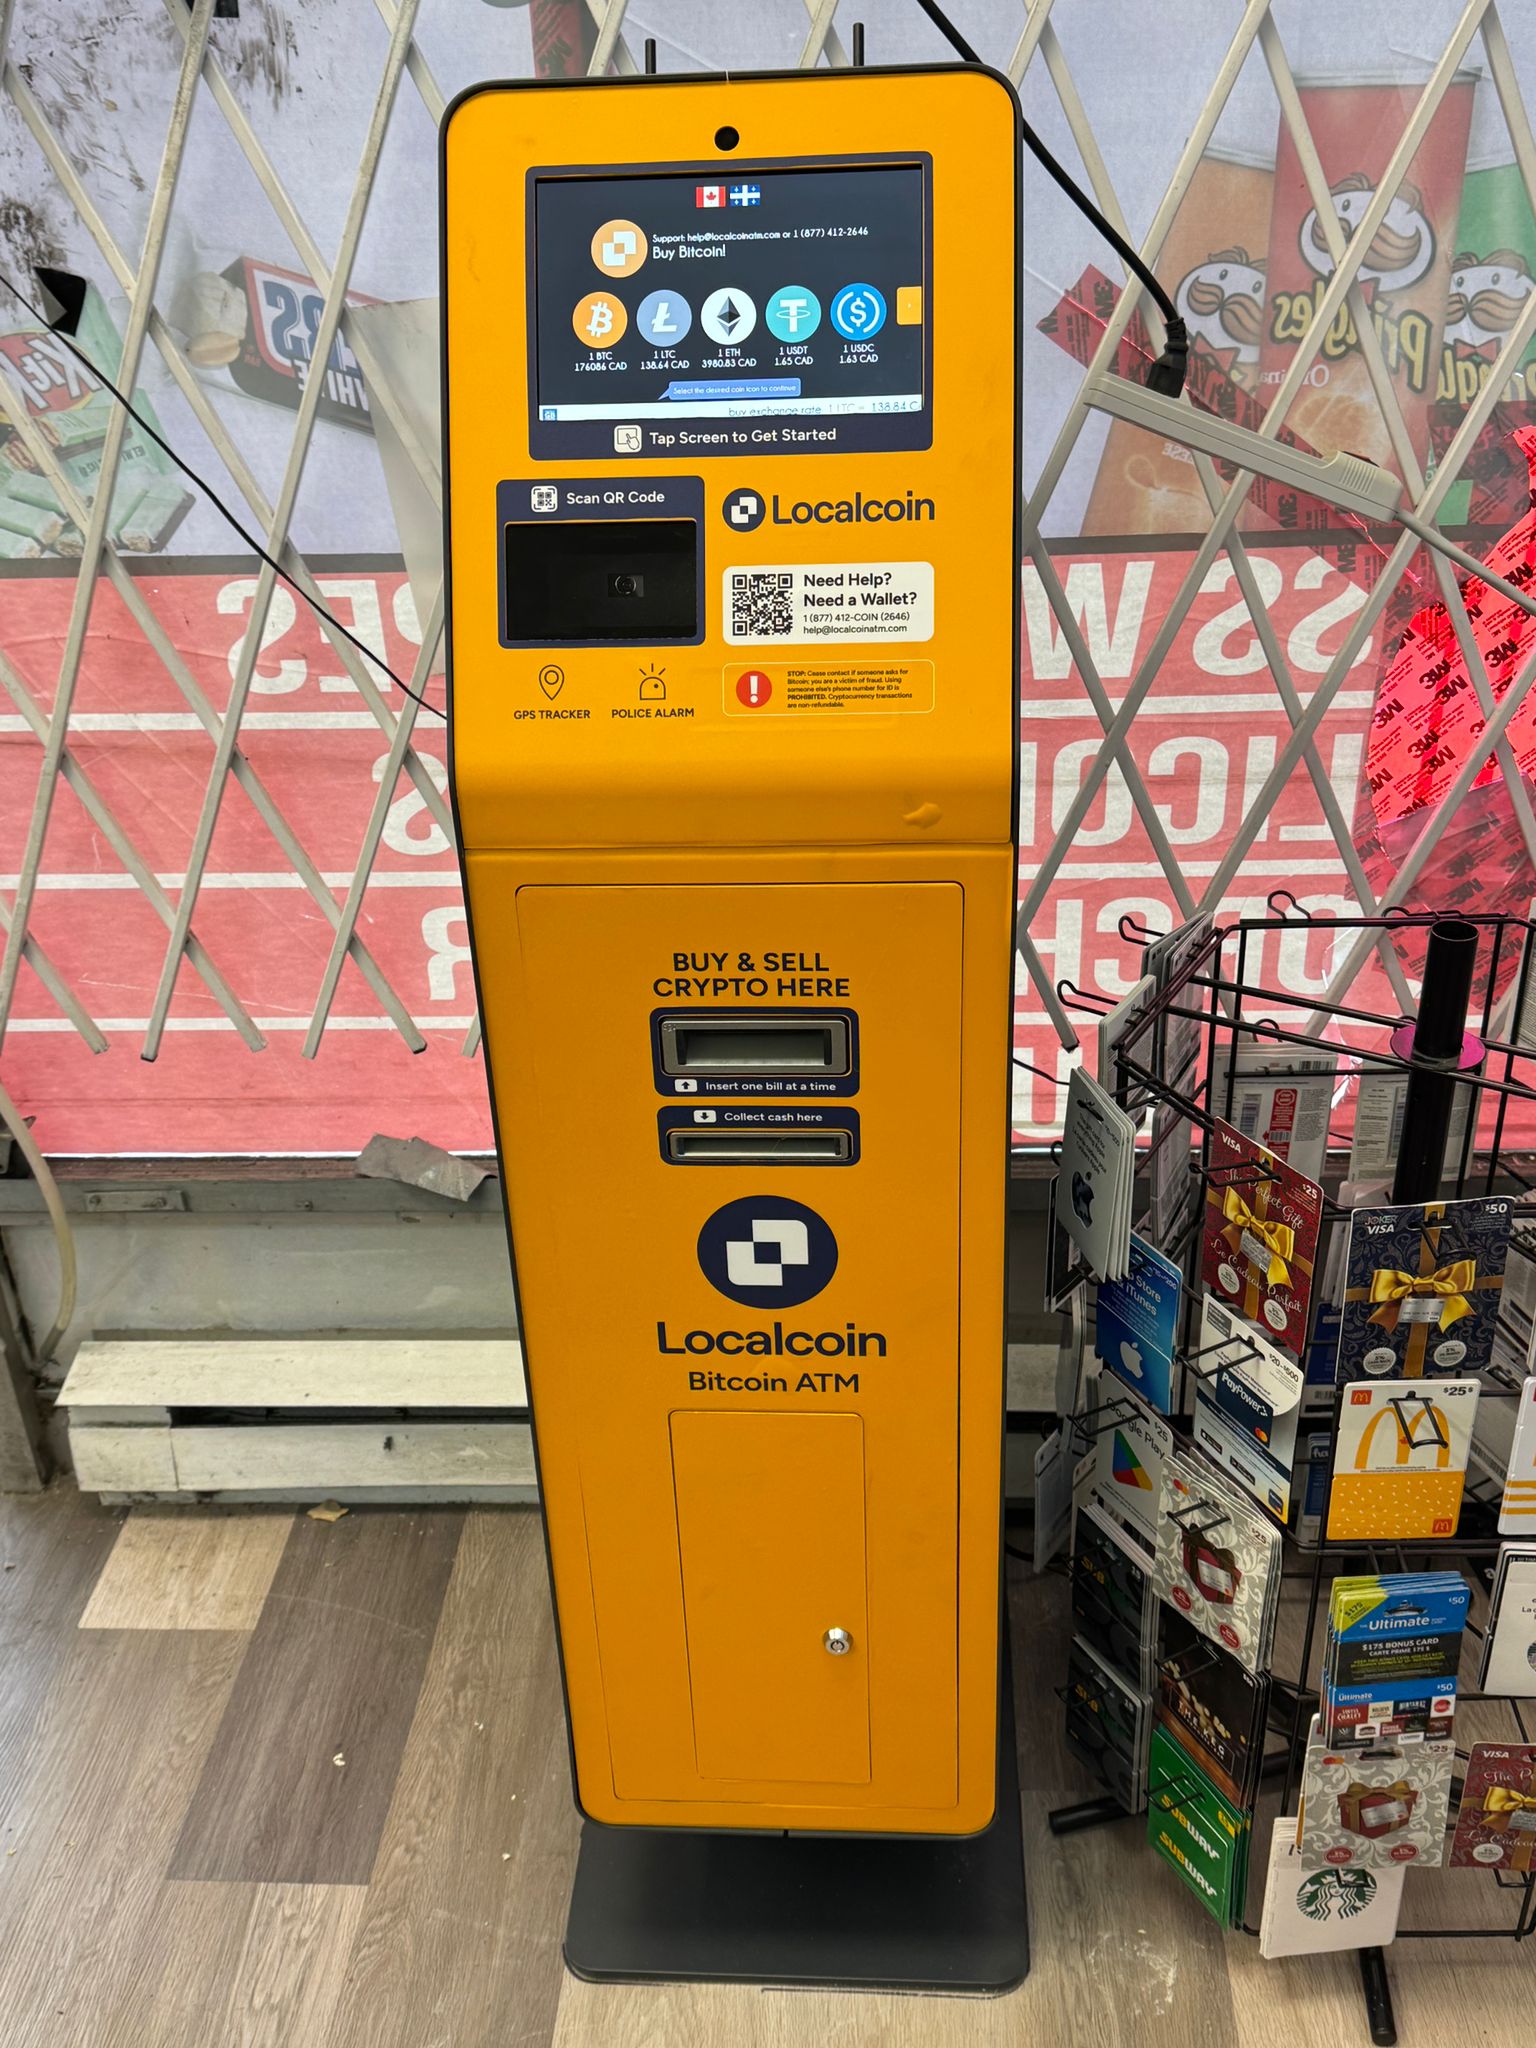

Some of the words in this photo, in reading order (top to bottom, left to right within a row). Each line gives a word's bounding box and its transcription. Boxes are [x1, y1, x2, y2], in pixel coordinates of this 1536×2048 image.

[652, 233, 686, 244] Support:
[687, 230, 781, 244] help@localcoinatm.com
[782, 231, 791, 239] or
[793, 229, 799, 238] 1
[800, 228, 825, 238] (877)
[826, 226, 869, 237] 412-2646
[652, 246, 675, 261] Buy
[678, 244, 726, 260] Bitcoin!
[725, 348, 741, 356] ETH
[786, 346, 808, 355] USDT
[850, 344, 874, 352] USDC
[596, 352, 613, 360] BTC
[661, 350, 676, 359] LTC
[839, 355, 858, 364] 1.63
[860, 354, 878, 363] CAD
[574, 362, 607, 372] 176086
[608, 362, 628, 370] CAD
[640, 361, 669, 370] 138.64
[671, 360, 690, 369] CAD
[702, 359, 736, 368] 3980.83
[738, 358, 757, 367] CAD
[774, 357, 792, 366] 1.65
[794, 356, 814, 366] CAD
[673, 387, 693, 395] Select
[694, 386, 704, 394] the
[706, 386, 729, 394] desired
[769, 384, 796, 392] continue
[650, 432, 676, 448] Tap
[679, 431, 728, 444] Screen
[732, 431, 748, 444] to
[751, 430, 778, 443] Get
[781, 428, 836, 442] Started
[566, 492, 600, 507] Scan
[602, 491, 626, 506] QR
[628, 490, 666, 505] Code
[772, 491, 936, 525] Localcoin
[803, 573, 845, 589] Need
[848, 572, 892, 588] Help?
[803, 592, 845, 608] Need
[848, 595, 857, 607] a
[860, 591, 918, 607] Wallet?
[803, 613, 807, 622] 1
[808, 612, 832, 624] (877)
[834, 612, 879, 622] 412-COIN
[880, 610, 910, 622] (2646)
[803, 624, 908, 636] help@localcoinatm.com
[884, 676, 902, 684] Using
[828, 692, 876, 700] Cryptocurrency
[514, 710, 536, 720] GPS
[538, 708, 592, 720] TRACKER
[611, 708, 652, 719] POLICE
[654, 708, 695, 718] ALARM
[672, 952, 729, 972] BUY
[737, 952, 756, 972] &
[763, 952, 830, 972] SELL
[652, 978, 769, 997] CRYPTO
[777, 978, 850, 997] HERE
[705, 1082, 739, 1091] Insert
[766, 1082, 783, 1091] bill
[786, 1082, 798, 1091] at
[809, 1082, 837, 1091] time
[724, 1112, 765, 1122] Collect
[768, 1112, 794, 1122] cash
[796, 1112, 823, 1122] here
[1220, 1132, 1242, 1154] VISA
[1302, 1183, 1319, 1200] $25
[1248, 1174, 1282, 1212] Perfect
[1282, 1206, 1304, 1230] Gift
[1485, 1203, 1508, 1214] $50
[1365, 1215, 1398, 1226] JOKER
[1367, 1224, 1395, 1235] VISA
[1210, 1238, 1227, 1261] Le
[1228, 1254, 1264, 1292] Cadeau
[1266, 1282, 1303, 1314] Parfait
[1136, 1274, 1162, 1303] Store
[1126, 1282, 1158, 1317] iTunes
[656, 1321, 888, 1357] Localcoin
[688, 1371, 788, 1392] Bitcoin
[795, 1373, 860, 1393] ATM
[1221, 1372, 1263, 1412] PayPower
[1106, 1396, 1143, 1438] Google
[1144, 1432, 1166, 1460] Play
[1154, 1420, 1169, 1442] $25
[1251, 1526, 1267, 1544] $25
[1448, 1596, 1466, 1605] $50
[1368, 1616, 1430, 1632] Ultimate
[1362, 1644, 1384, 1652] $175
[1385, 1640, 1415, 1650] BONUS
[1416, 1638, 1440, 1646] CARD
[1391, 1648, 1412, 1656] PRIME
[1437, 1683, 1454, 1692] $50
[1338, 1692, 1373, 1702] Ultimate
[1203, 1726, 1226, 1756] KEG
[1428, 1746, 1448, 1754] $25
[1482, 1750, 1510, 1759] VISA
[1159, 1831, 1218, 1897] SUBWAY
